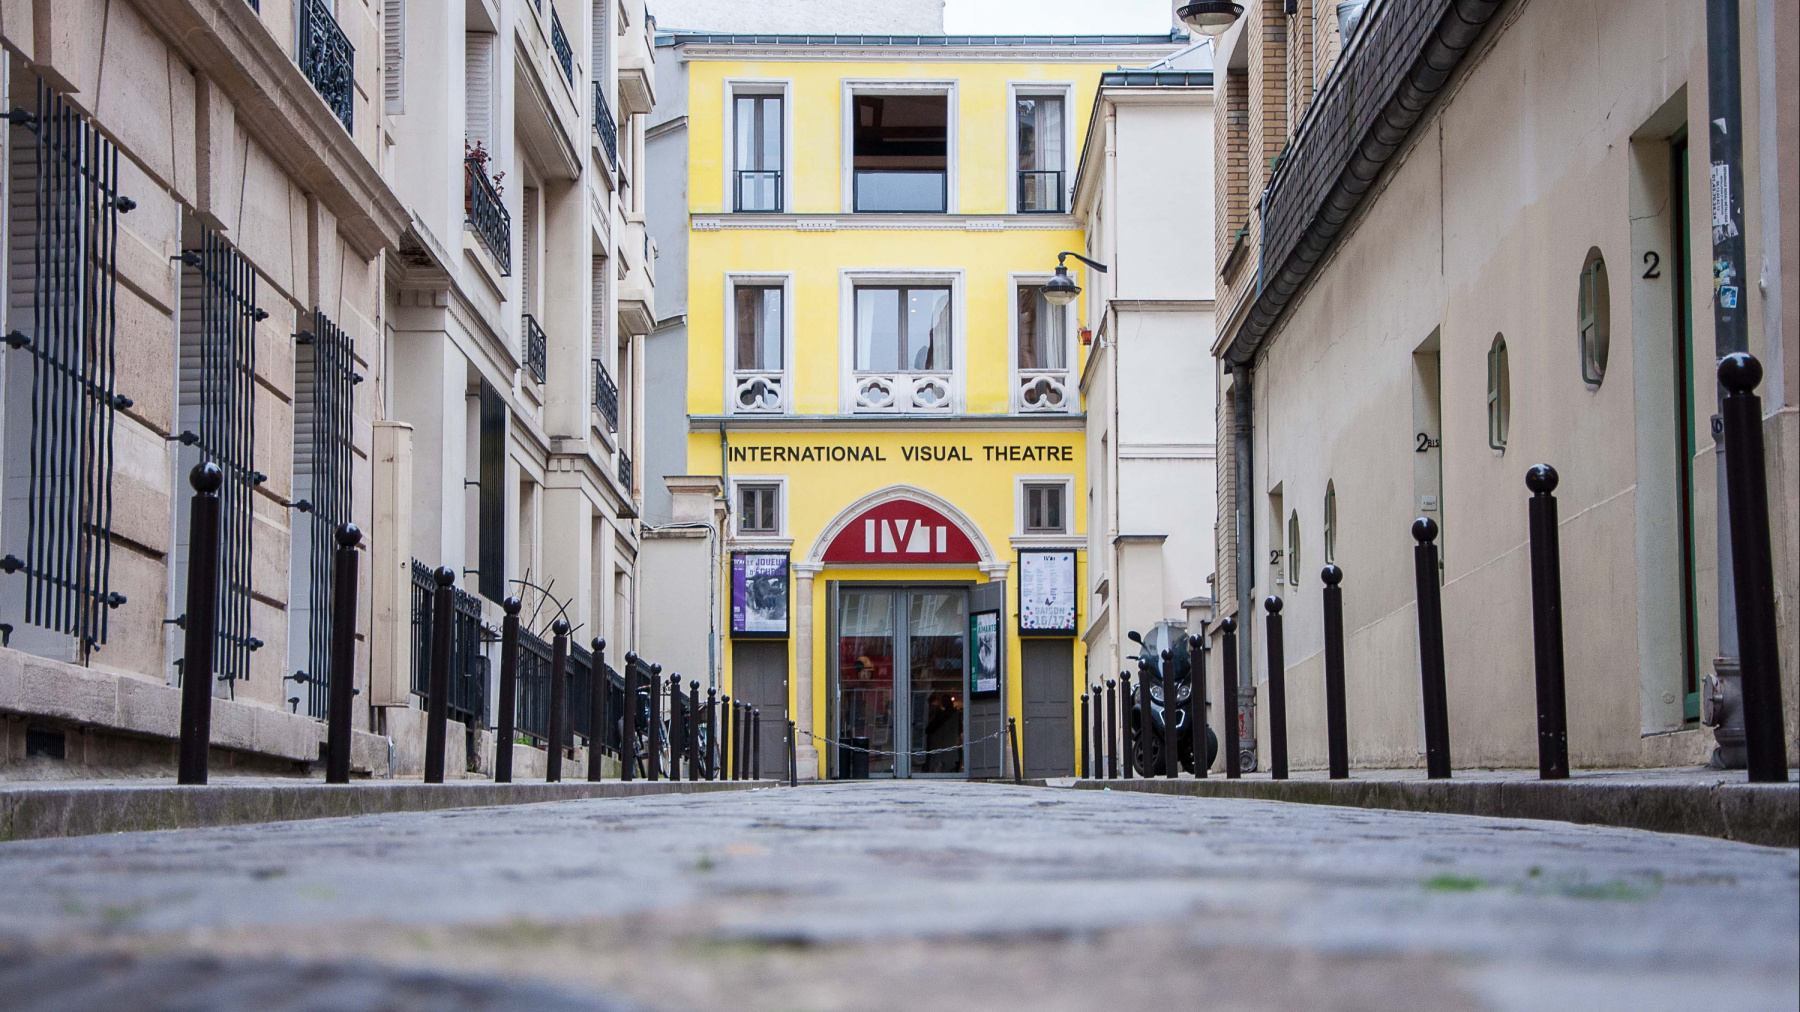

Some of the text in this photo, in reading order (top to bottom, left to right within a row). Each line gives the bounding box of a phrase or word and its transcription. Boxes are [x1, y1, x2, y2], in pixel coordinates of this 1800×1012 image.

[1642, 250, 1660, 279] 2
[729, 446, 1073, 462] INTERNATIONAL VISUAL THEATRE
[1035, 607, 1065, 615] SAISON
[1035, 615, 1065, 626] 16/17
